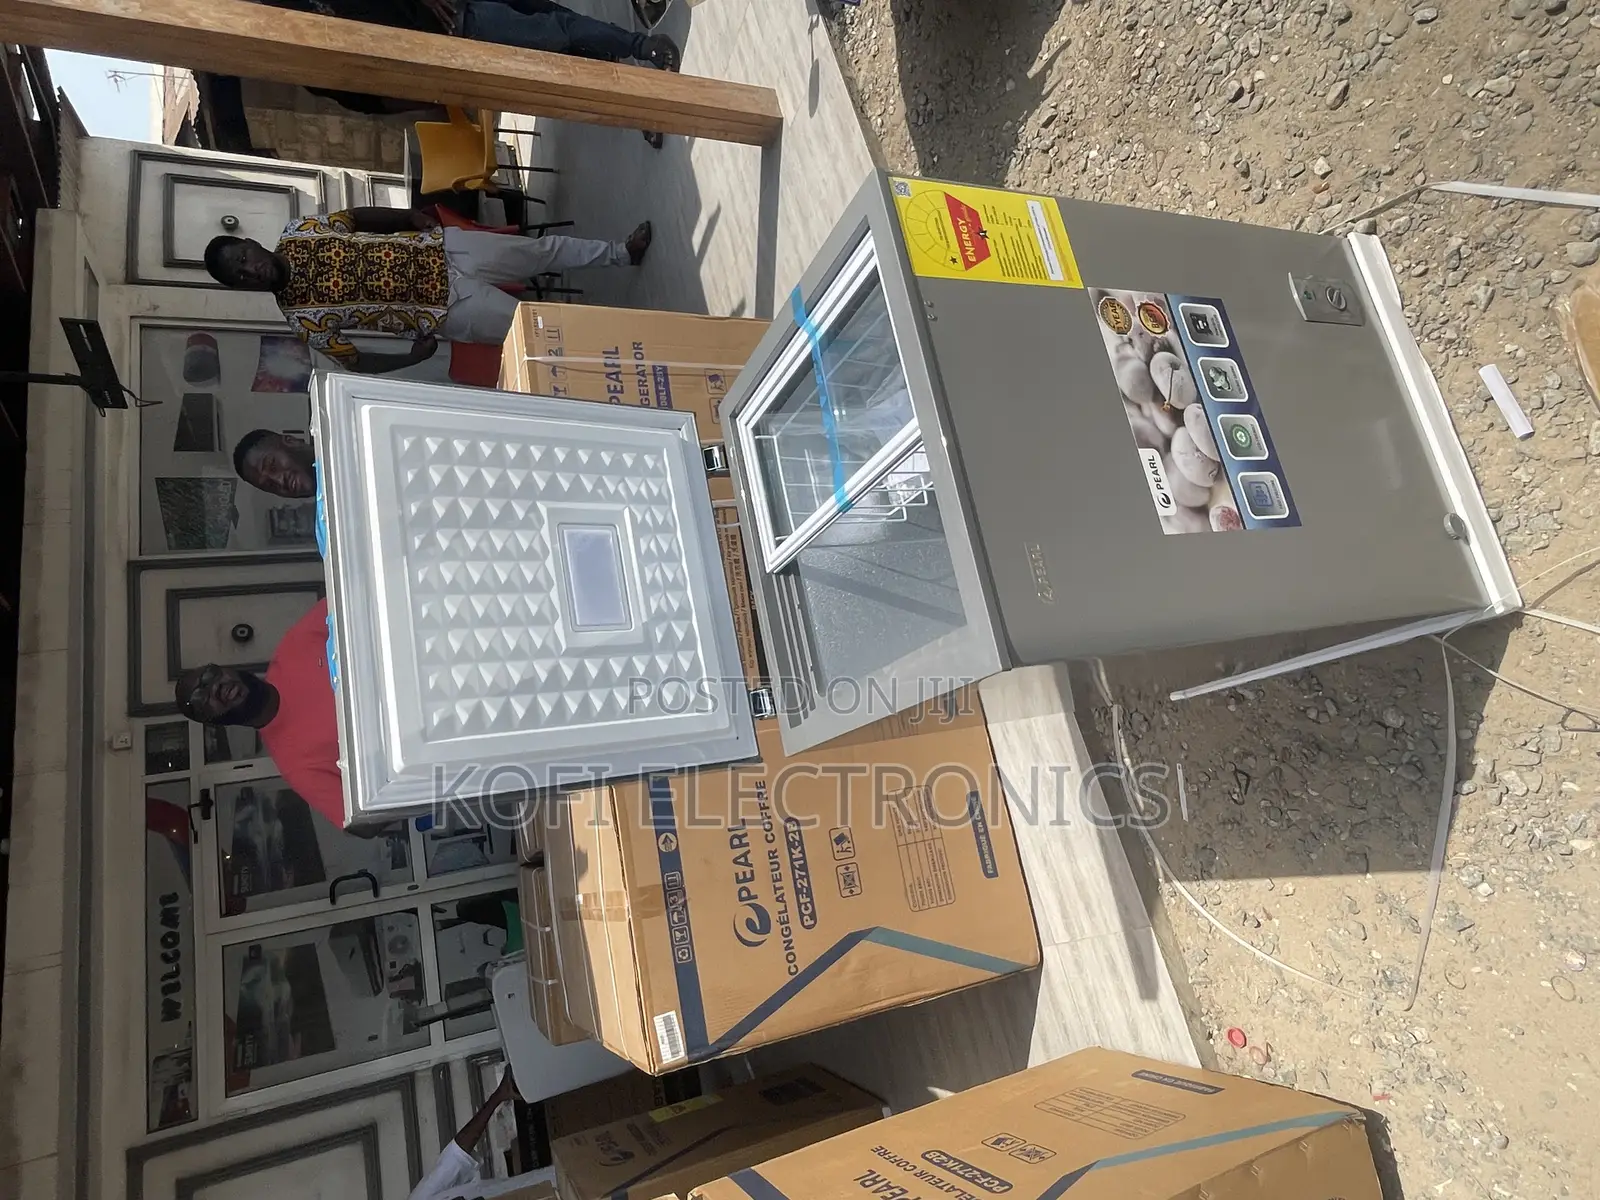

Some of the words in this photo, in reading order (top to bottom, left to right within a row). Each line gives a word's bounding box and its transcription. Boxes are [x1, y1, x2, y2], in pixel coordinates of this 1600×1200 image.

[957, 217, 976, 262] ENERGY
[1109, 301, 1121, 325] YEAR
[1146, 308, 1160, 329] BEST
[602, 346, 625, 405] PEARL
[1148, 455, 1164, 491] PEARL
[1030, 544, 1049, 584] PEARL
[754, 780, 776, 844] COFFRE
[727, 817, 759, 902] PEARL
[786, 820, 815, 926] PCF-271K-2B
[767, 849, 800, 976] CONGÉLATEUR
[158, 891, 182, 1023] WELCOME
[871, 1145, 917, 1172] COFFRE
[925, 1151, 1010, 1193] PCF-271K-2B
[852, 1169, 921, 1200] EARL
